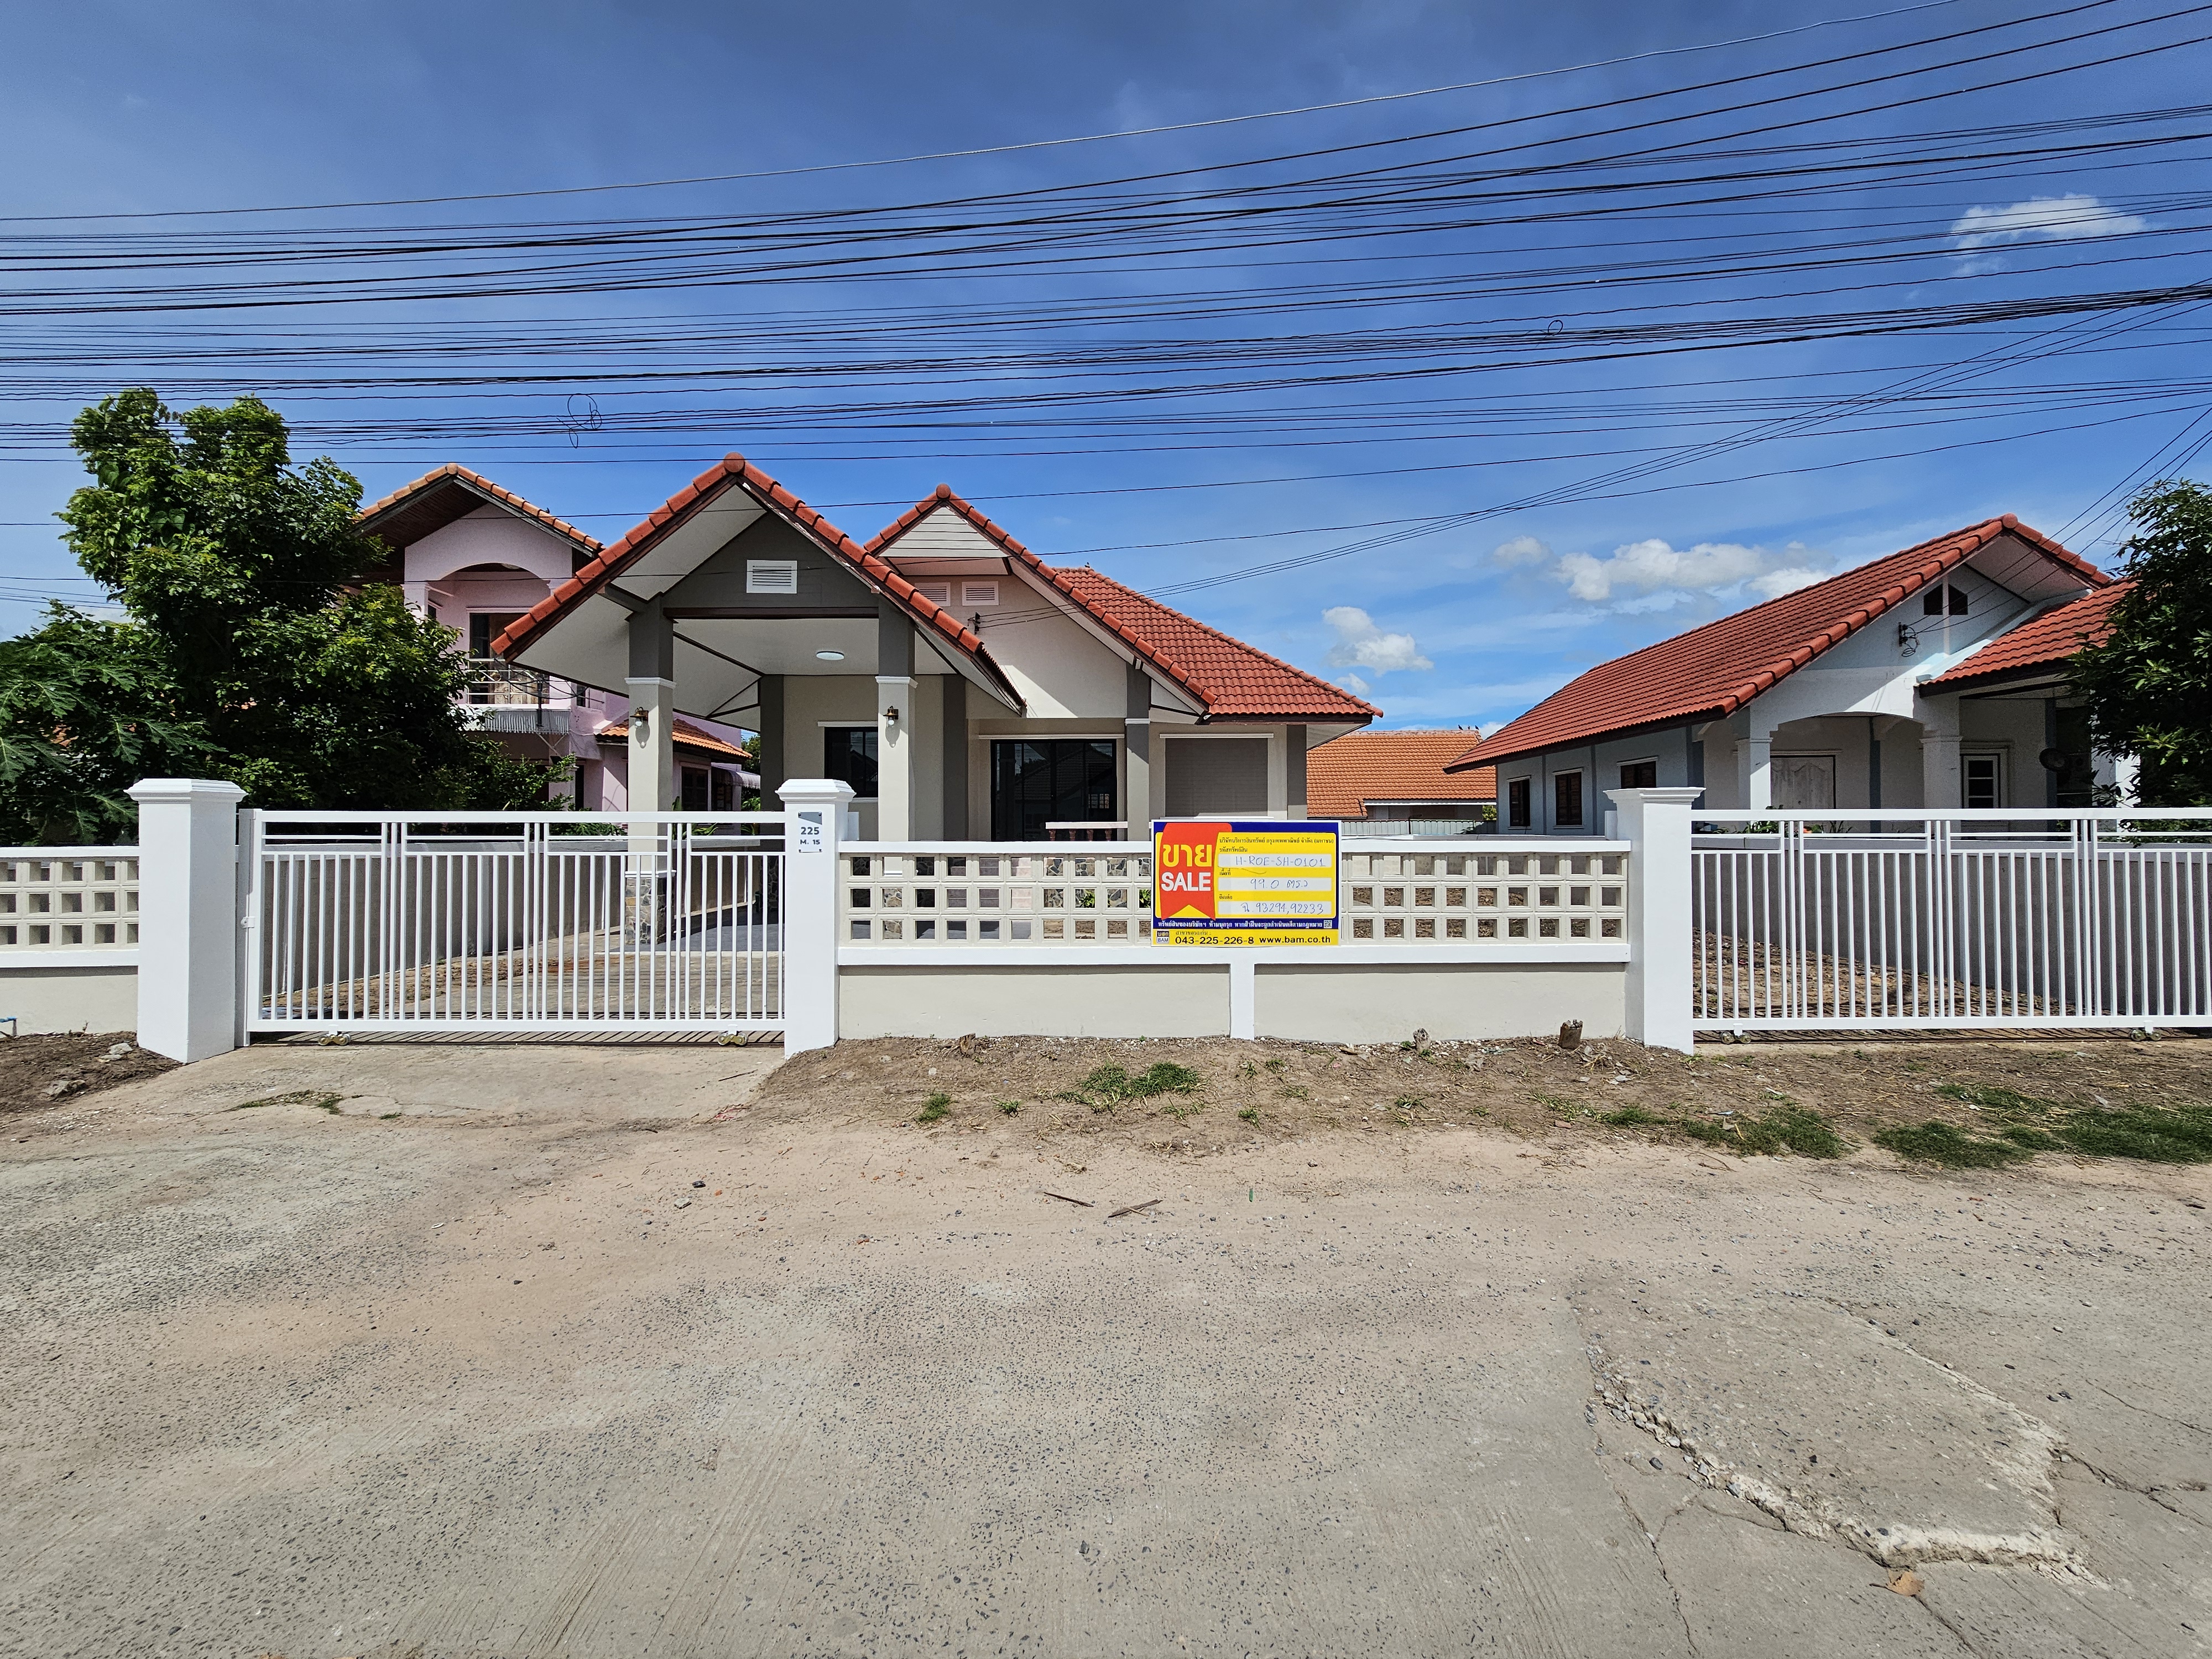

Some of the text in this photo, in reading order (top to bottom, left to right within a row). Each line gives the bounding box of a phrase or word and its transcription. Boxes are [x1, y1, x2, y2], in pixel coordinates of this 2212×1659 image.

[801, 827, 820, 835] 225
[1162, 844, 1212, 867] ขาย
[1235, 855, 1326, 867] H-ROE-SH-0101
[1161, 872, 1211, 891] SALE
[1250, 878, 1279, 889] 99.0
[1175, 936, 1254, 945] 043-225-226-8
